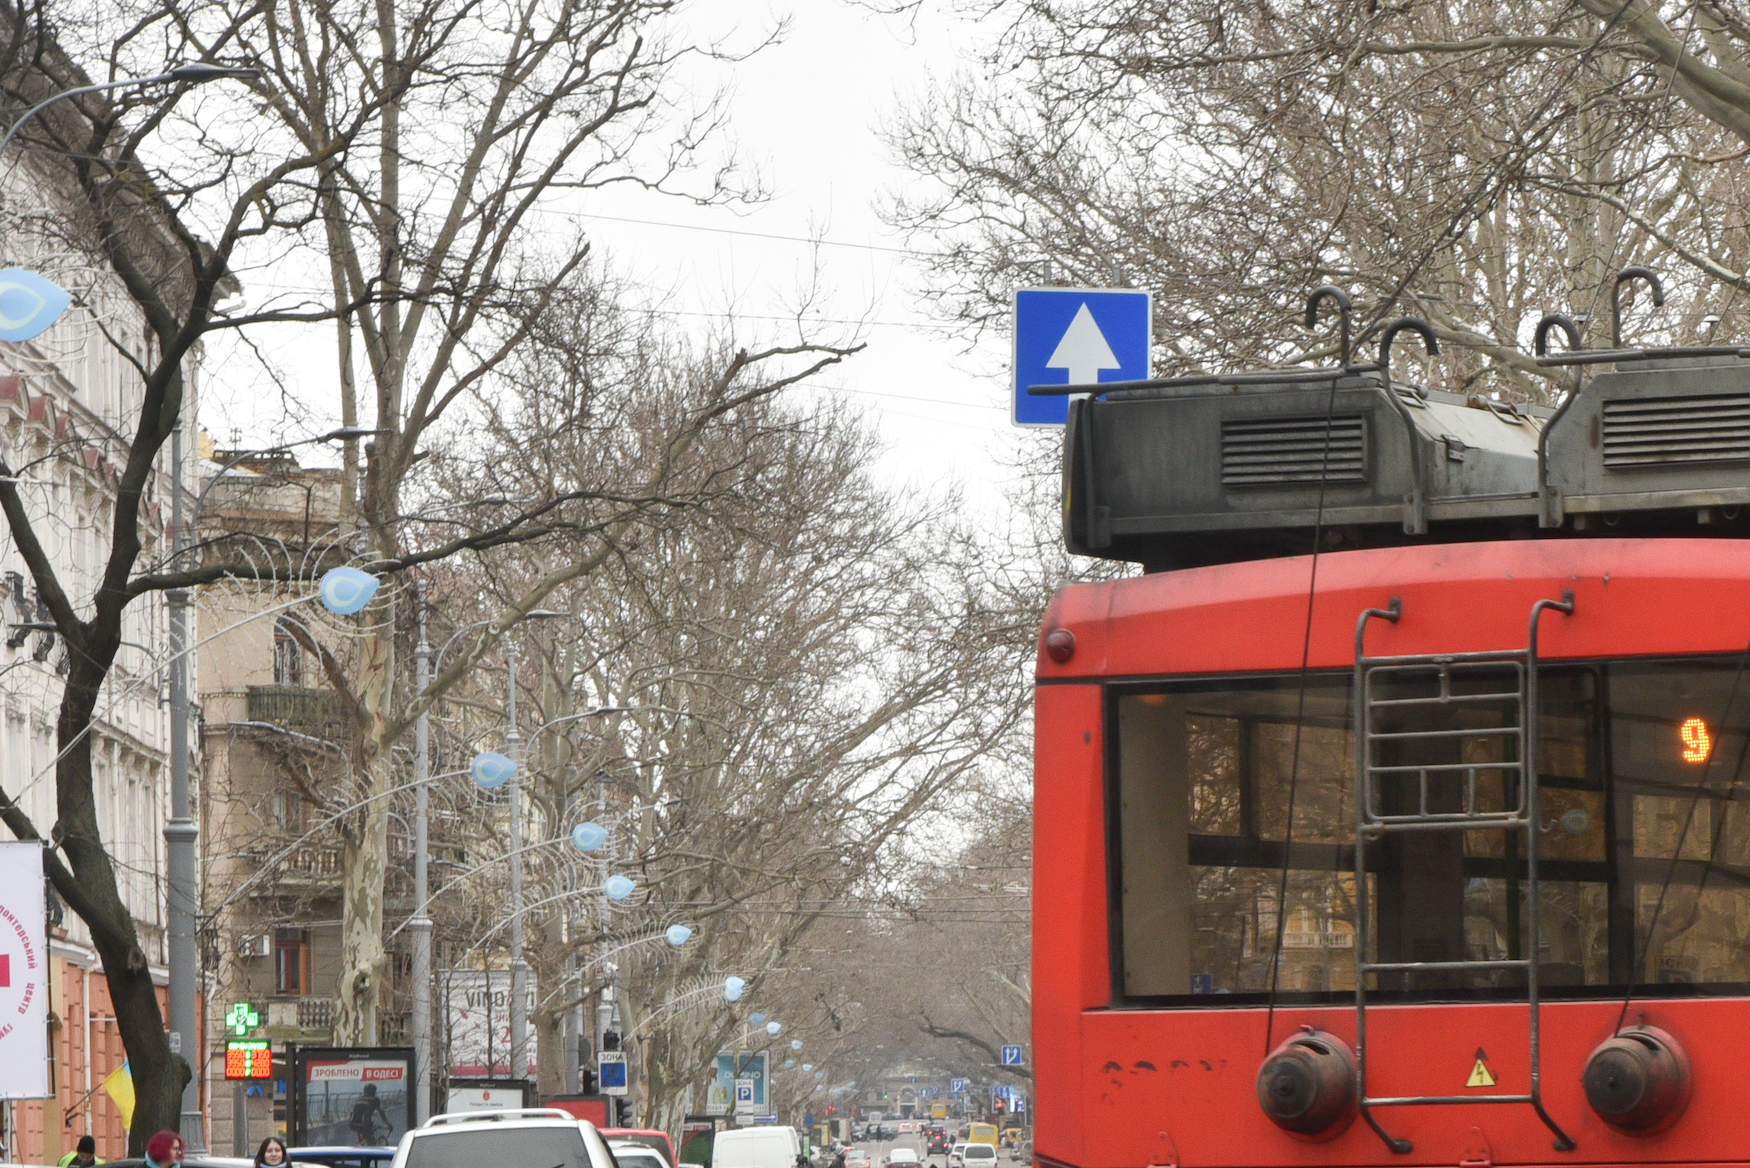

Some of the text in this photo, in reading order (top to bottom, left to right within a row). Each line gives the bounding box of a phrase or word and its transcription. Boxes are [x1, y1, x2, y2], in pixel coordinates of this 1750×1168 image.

[1681, 718, 1710, 763] 9
[601, 1053, 622, 1061] ЗОНА
[314, 1068, 359, 1077] ЗРОБЛЕНО
[374, 1069, 399, 1078] ОДЕСІ
